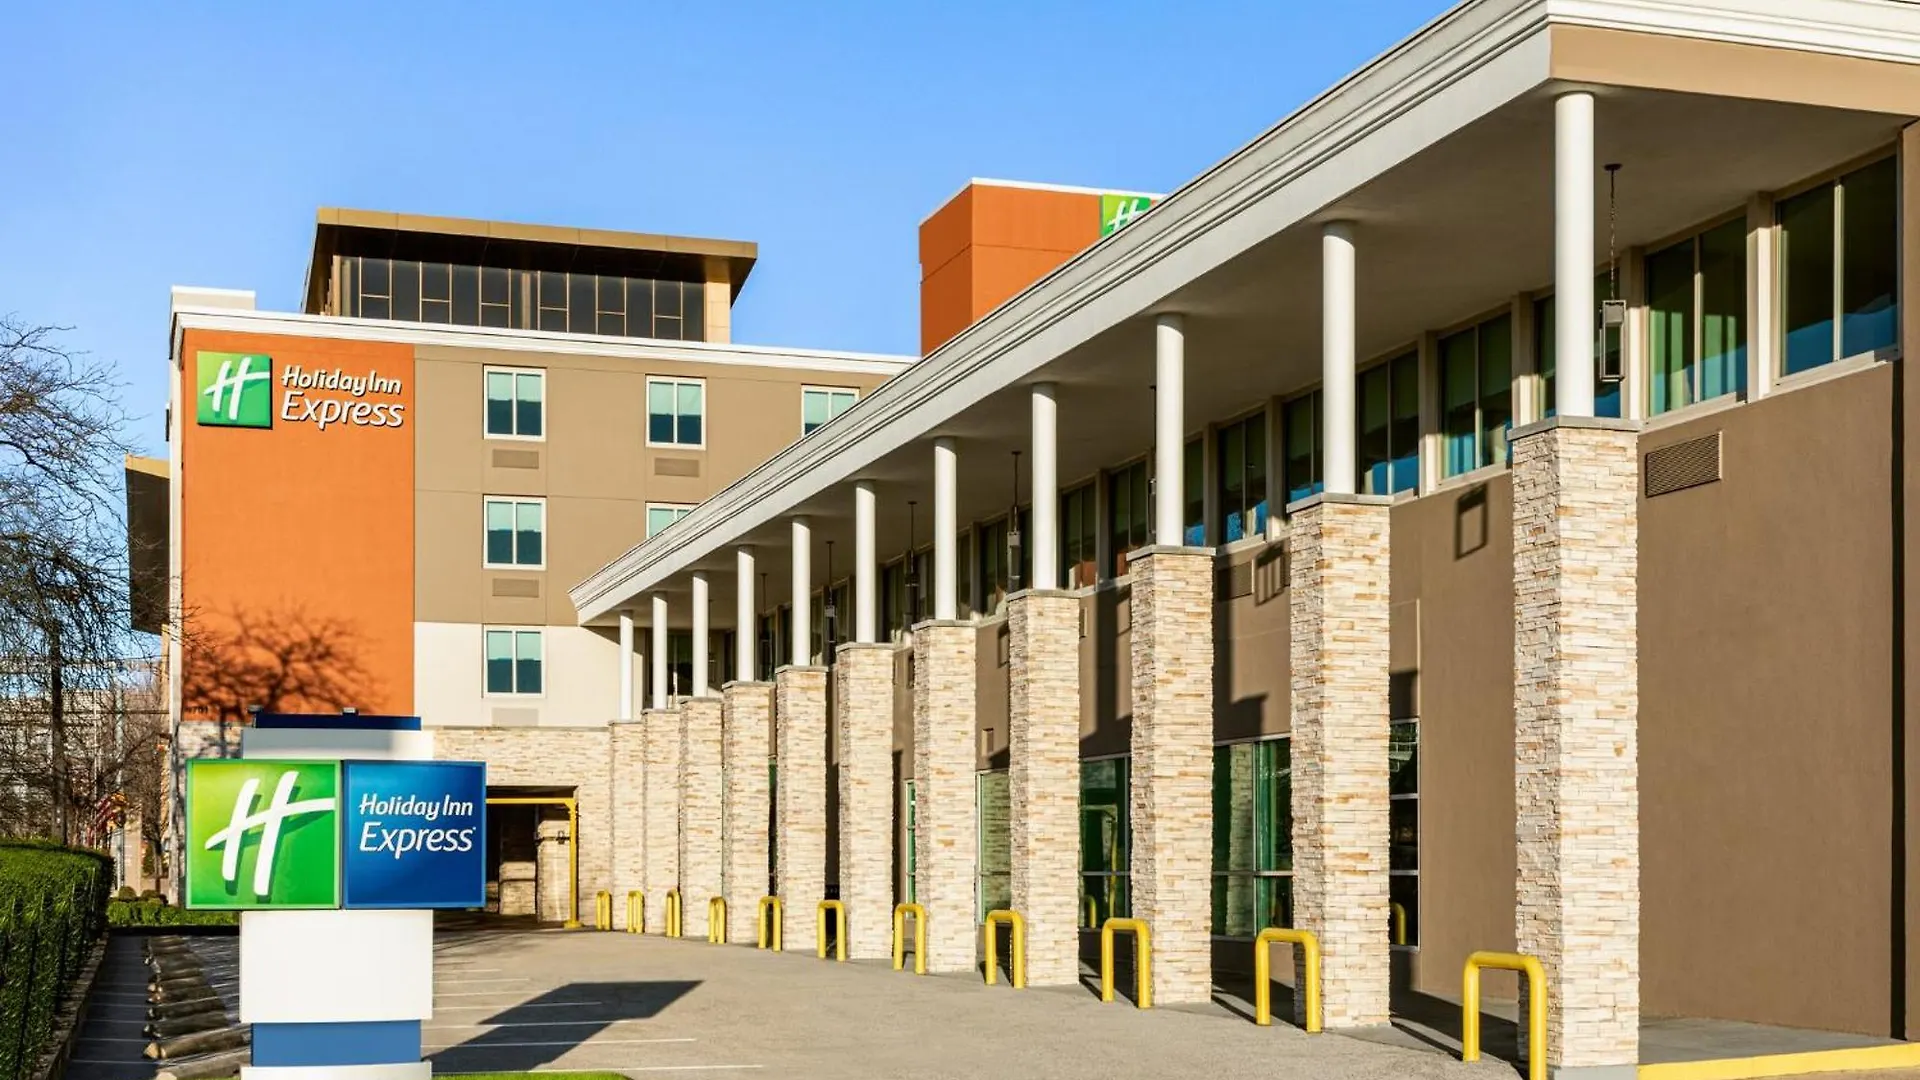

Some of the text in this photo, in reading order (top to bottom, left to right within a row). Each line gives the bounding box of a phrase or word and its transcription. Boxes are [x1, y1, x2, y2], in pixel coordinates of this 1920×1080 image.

[281, 365, 402, 396] Holiday Inn
[281, 390, 404, 431] Express
[359, 793, 473, 820] Holiday Inn
[360, 822, 474, 860] Express
